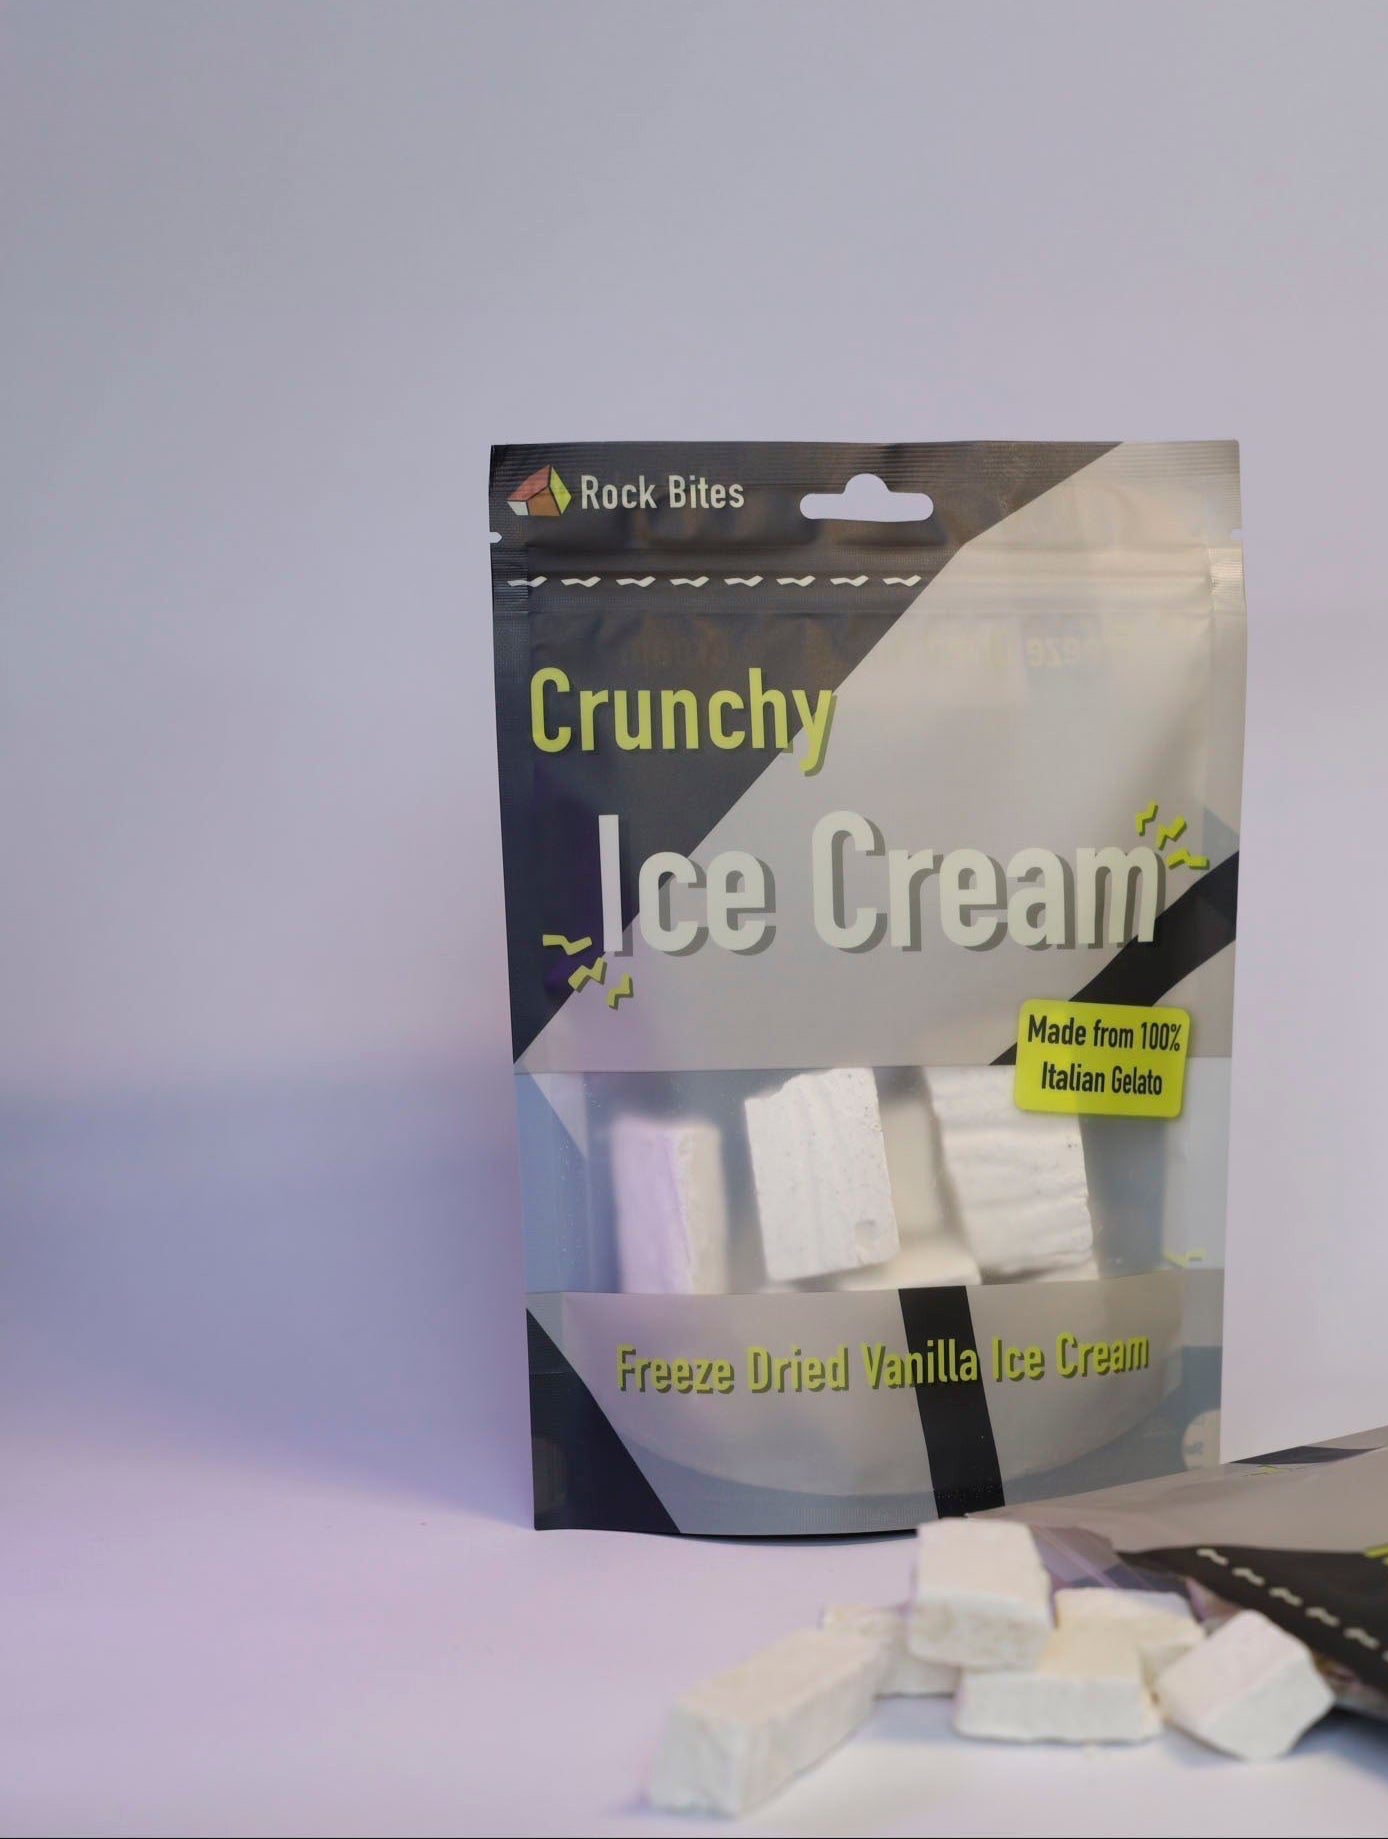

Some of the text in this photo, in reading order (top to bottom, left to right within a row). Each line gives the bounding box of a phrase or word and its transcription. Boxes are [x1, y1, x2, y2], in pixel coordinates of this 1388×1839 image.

[581, 475, 745, 510] Rock Bites
[529, 666, 836, 776] Crunchy
[598, 811, 1164, 956] Ice Cream
[1027, 1014, 1182, 1052] Made from 100%
[1041, 1061, 1162, 1096] Italian Gelato
[616, 1331, 1149, 1395] Freeze Dried Vanilla Ice Cream
